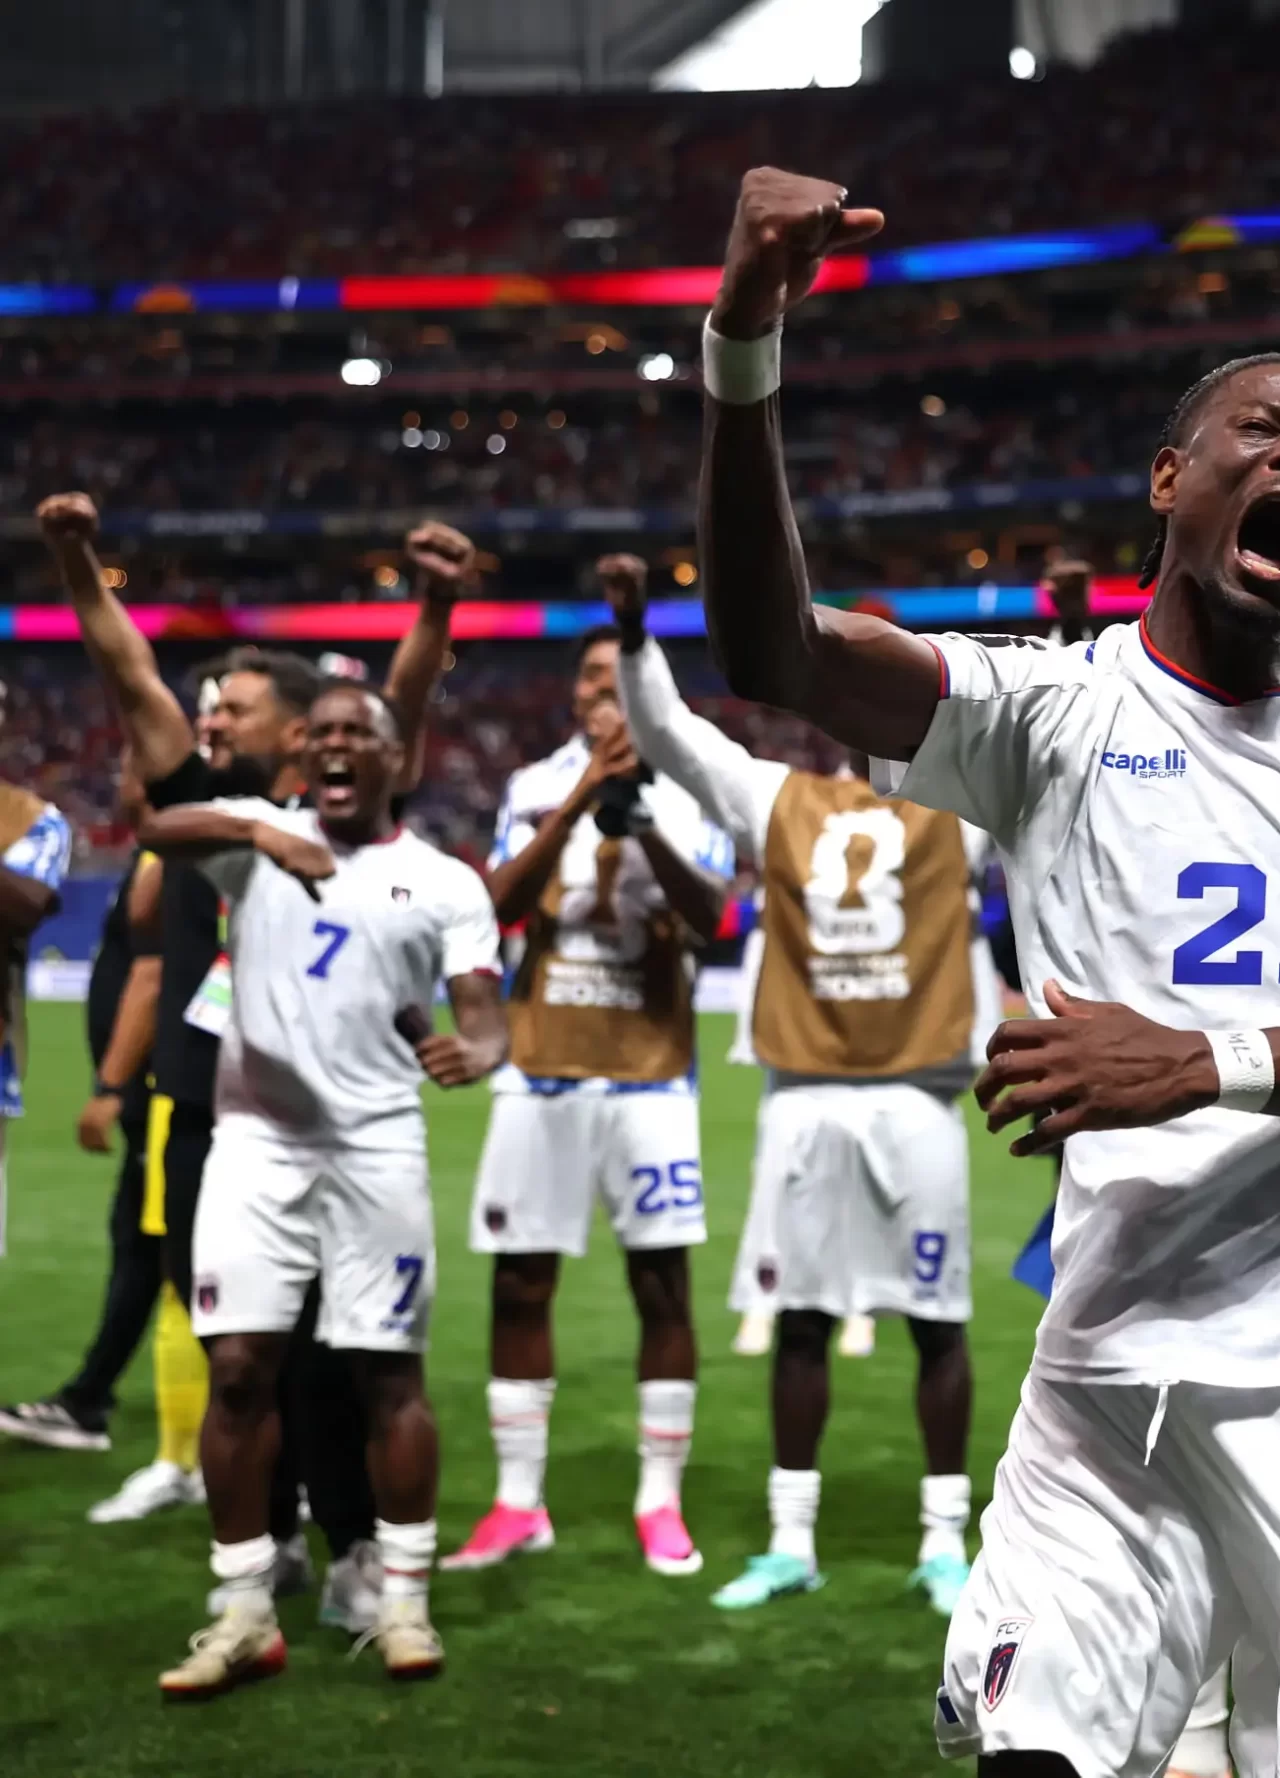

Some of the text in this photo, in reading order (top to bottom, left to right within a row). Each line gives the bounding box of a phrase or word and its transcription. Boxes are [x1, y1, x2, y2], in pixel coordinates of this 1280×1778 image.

[1101, 748, 1187, 776] capelli
[1138, 770, 1187, 780] SPORT
[306, 920, 350, 980] 7
[630, 1159, 703, 1214] 25
[914, 1230, 947, 1284] 9
[393, 1254, 424, 1315] 7
